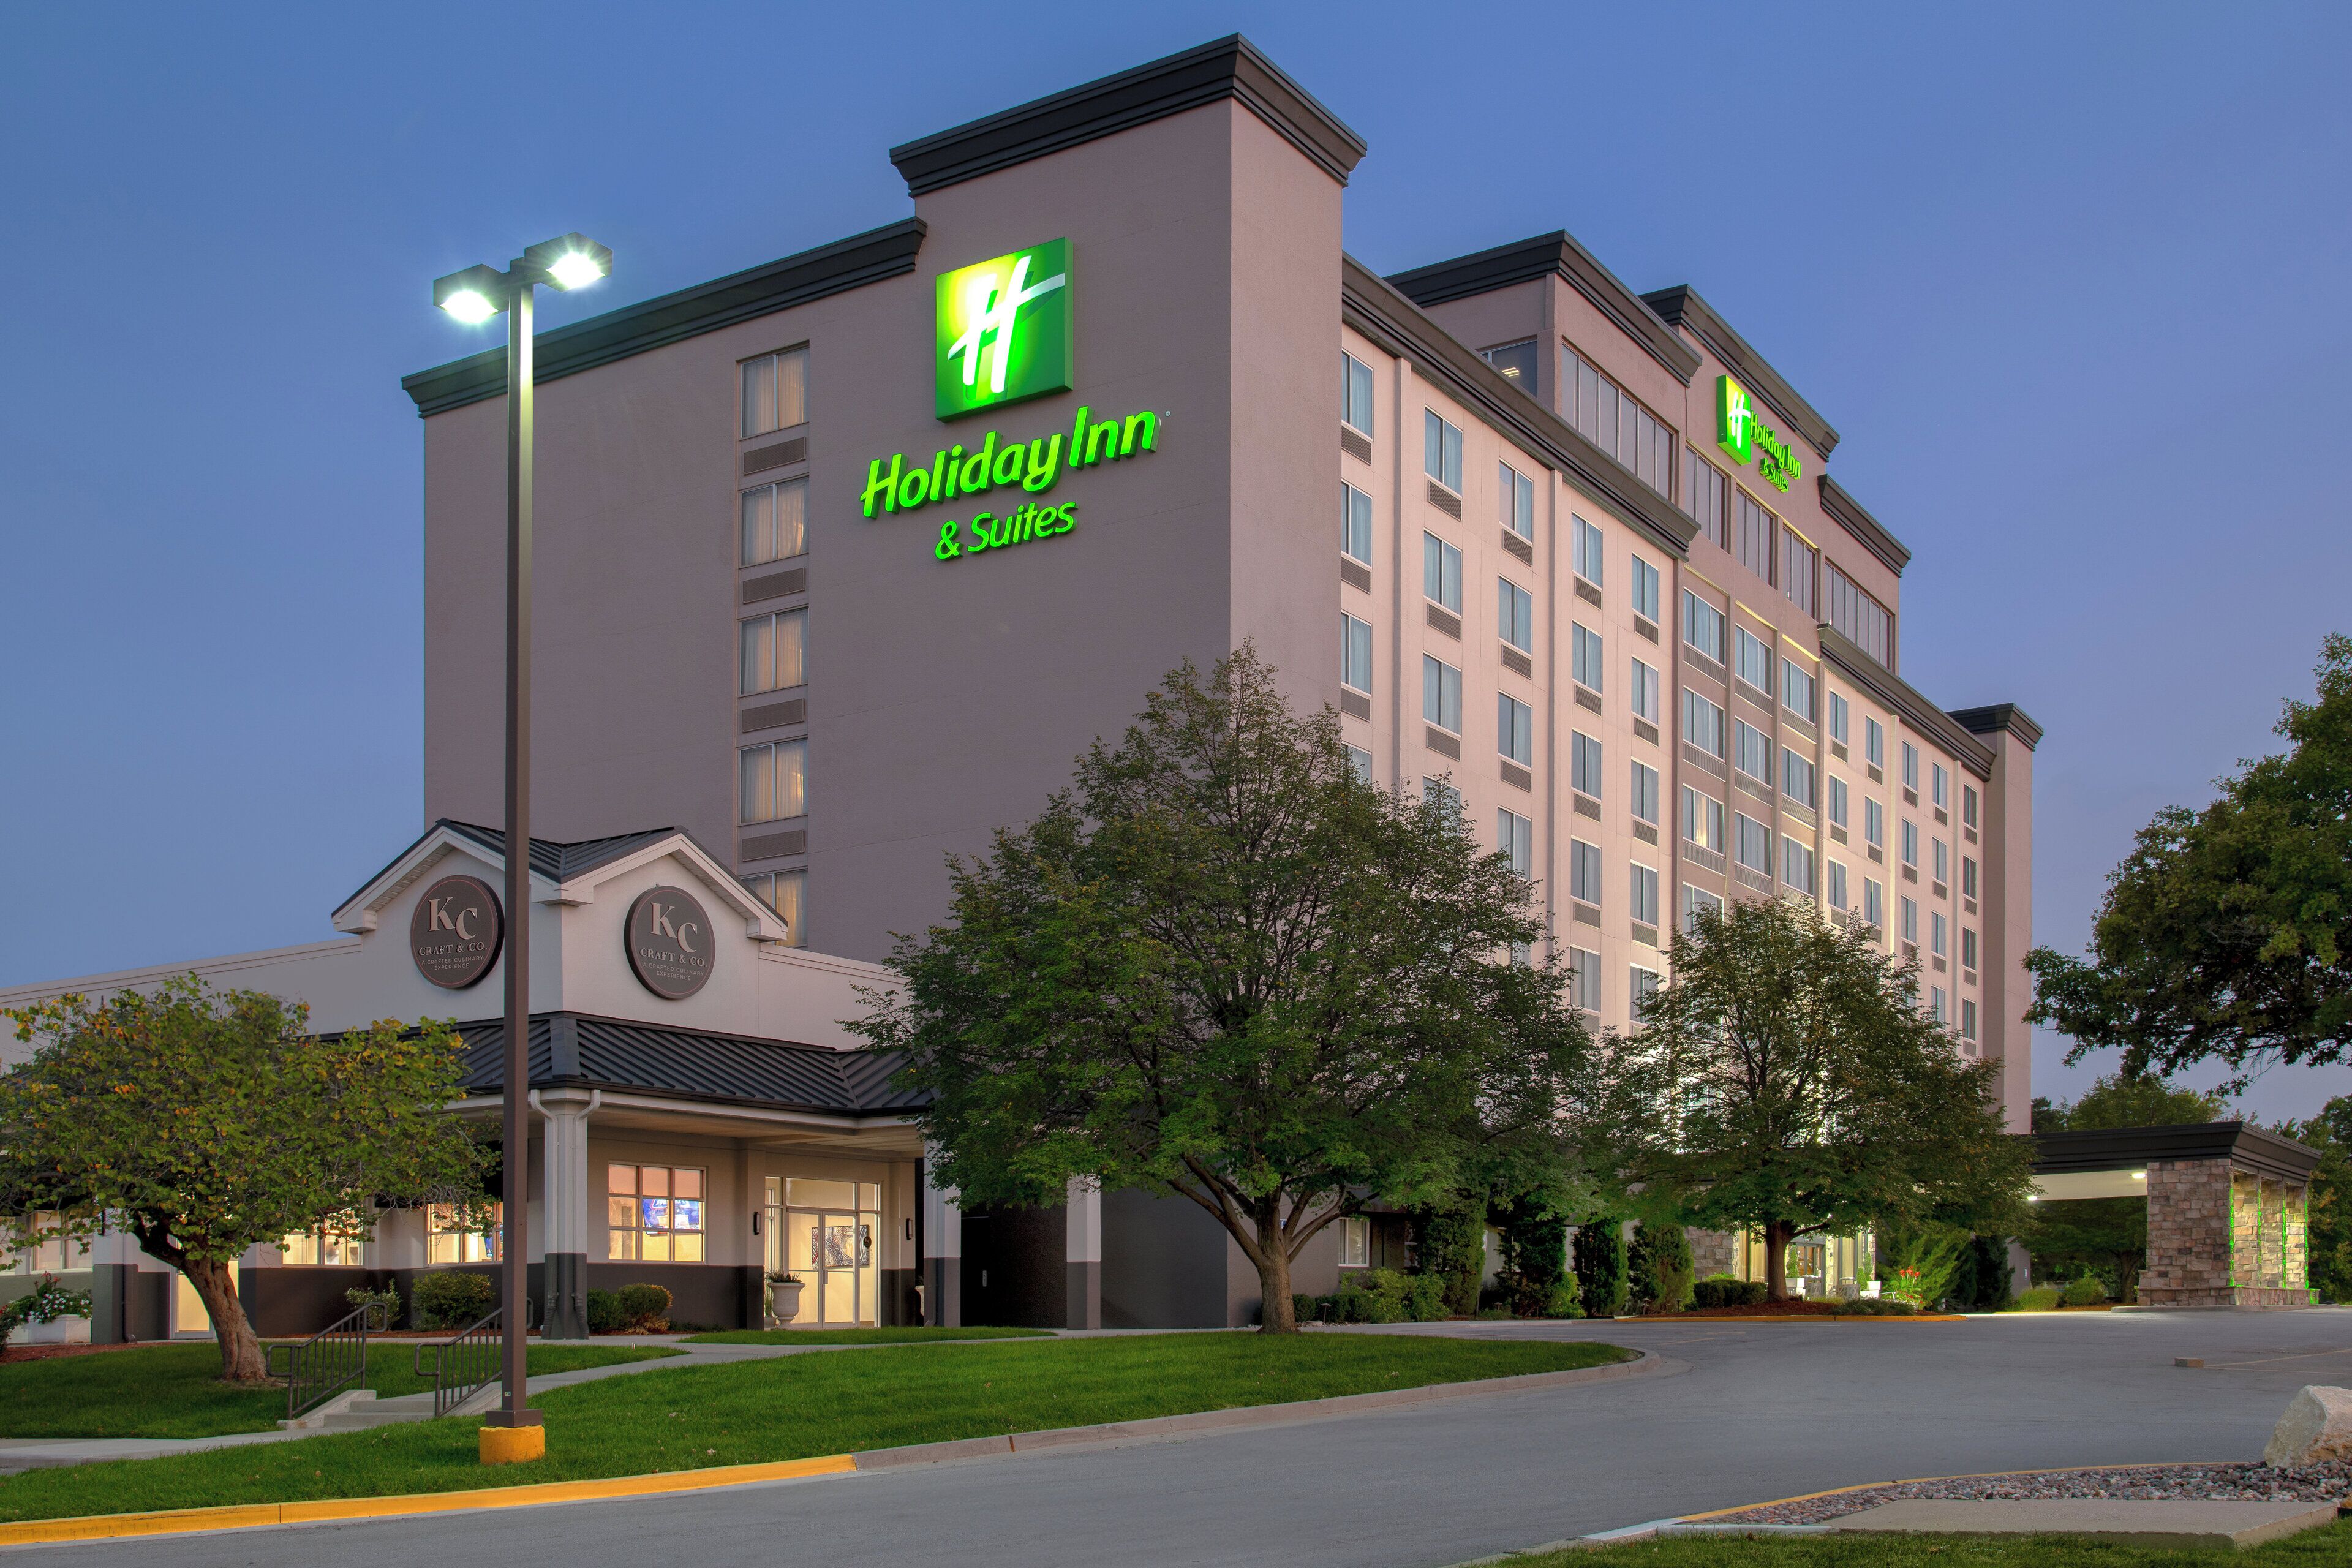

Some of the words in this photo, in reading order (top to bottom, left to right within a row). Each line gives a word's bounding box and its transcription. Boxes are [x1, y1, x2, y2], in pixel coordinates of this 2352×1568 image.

[860, 431, 1068, 519] Holiday
[1068, 406, 1161, 469] Inn
[1751, 410, 1786, 469] Holiday
[1784, 444, 1801, 480] Inn
[1766, 463, 1789, 493] Suites
[935, 521, 963, 560] &
[967, 502, 1079, 552] Suites
[428, 897, 477, 940] KC
[650, 902, 697, 952] KC
[419, 944, 453, 956] CRAFT
[457, 943, 464, 953] &
[468, 942, 488, 951] CO.
[640, 948, 675, 962] CRAFT
[679, 954, 685, 963] &
[690, 957, 707, 967] CO.
[649, 963, 674, 971] CRAFTED
[657, 971, 691, 981] EXPERIENCE
